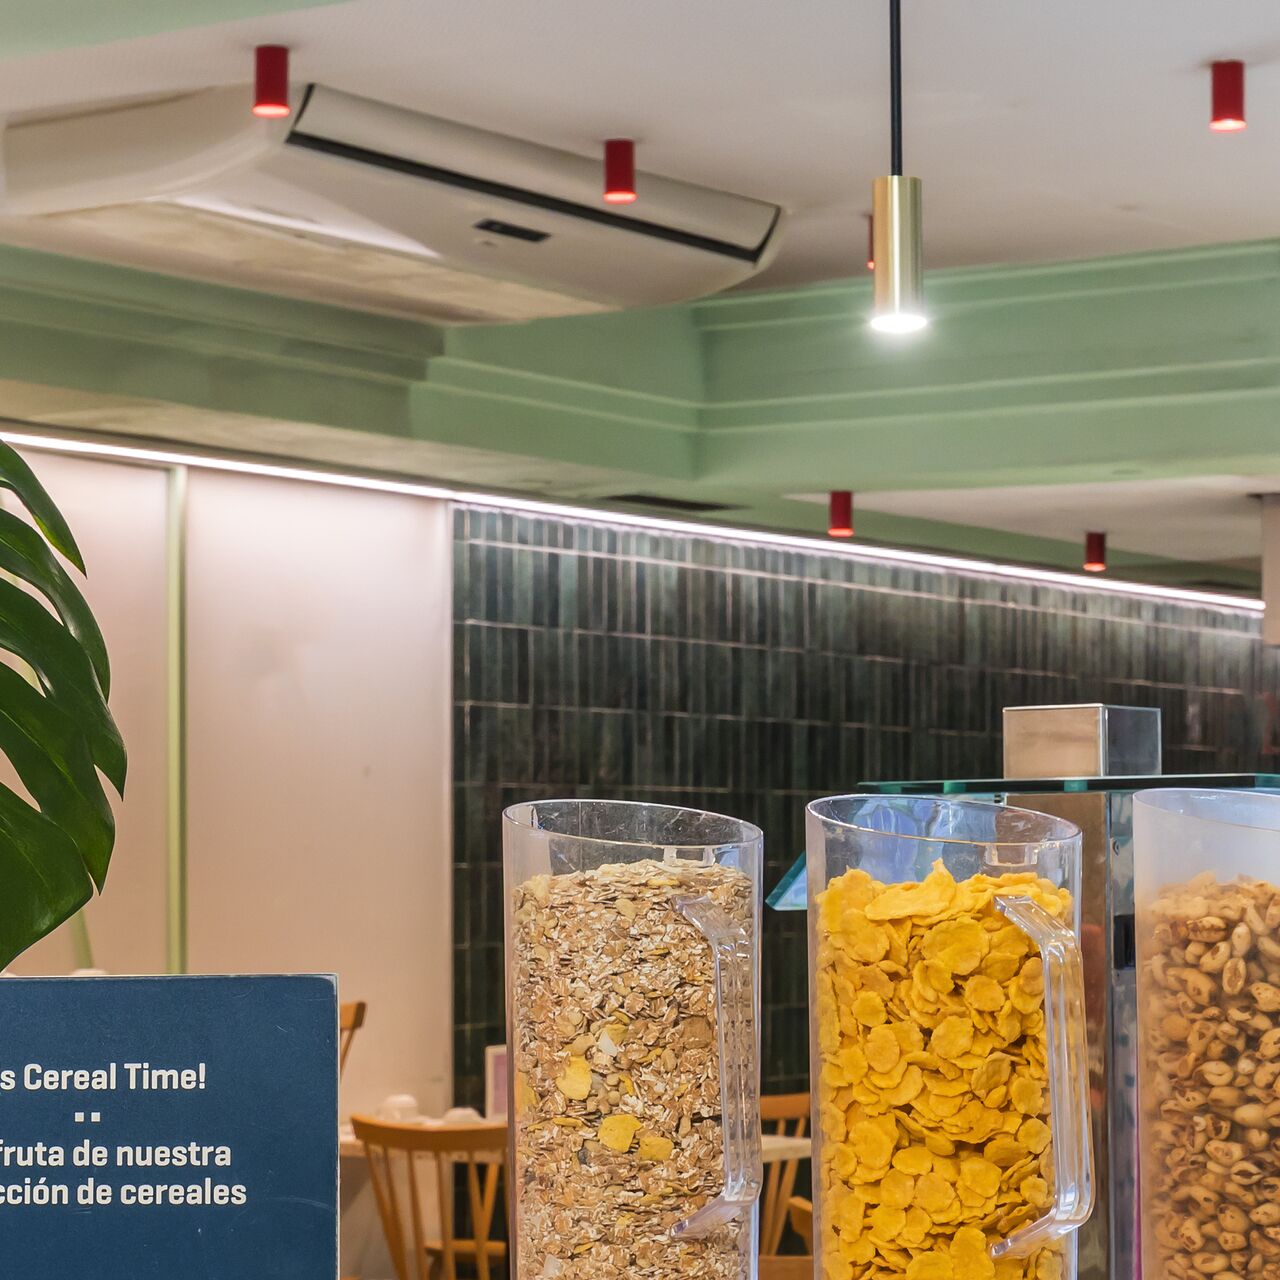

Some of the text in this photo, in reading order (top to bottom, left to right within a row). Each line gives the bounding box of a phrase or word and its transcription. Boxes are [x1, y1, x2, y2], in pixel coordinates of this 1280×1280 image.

[23, 1062, 117, 1090] Cereal
[124, 1062, 206, 1090] Time!
[72, 1138, 108, 1167] de
[116, 1142, 232, 1167] nuestra
[76, 1177, 112, 1205] de
[120, 1177, 247, 1205] cereales
